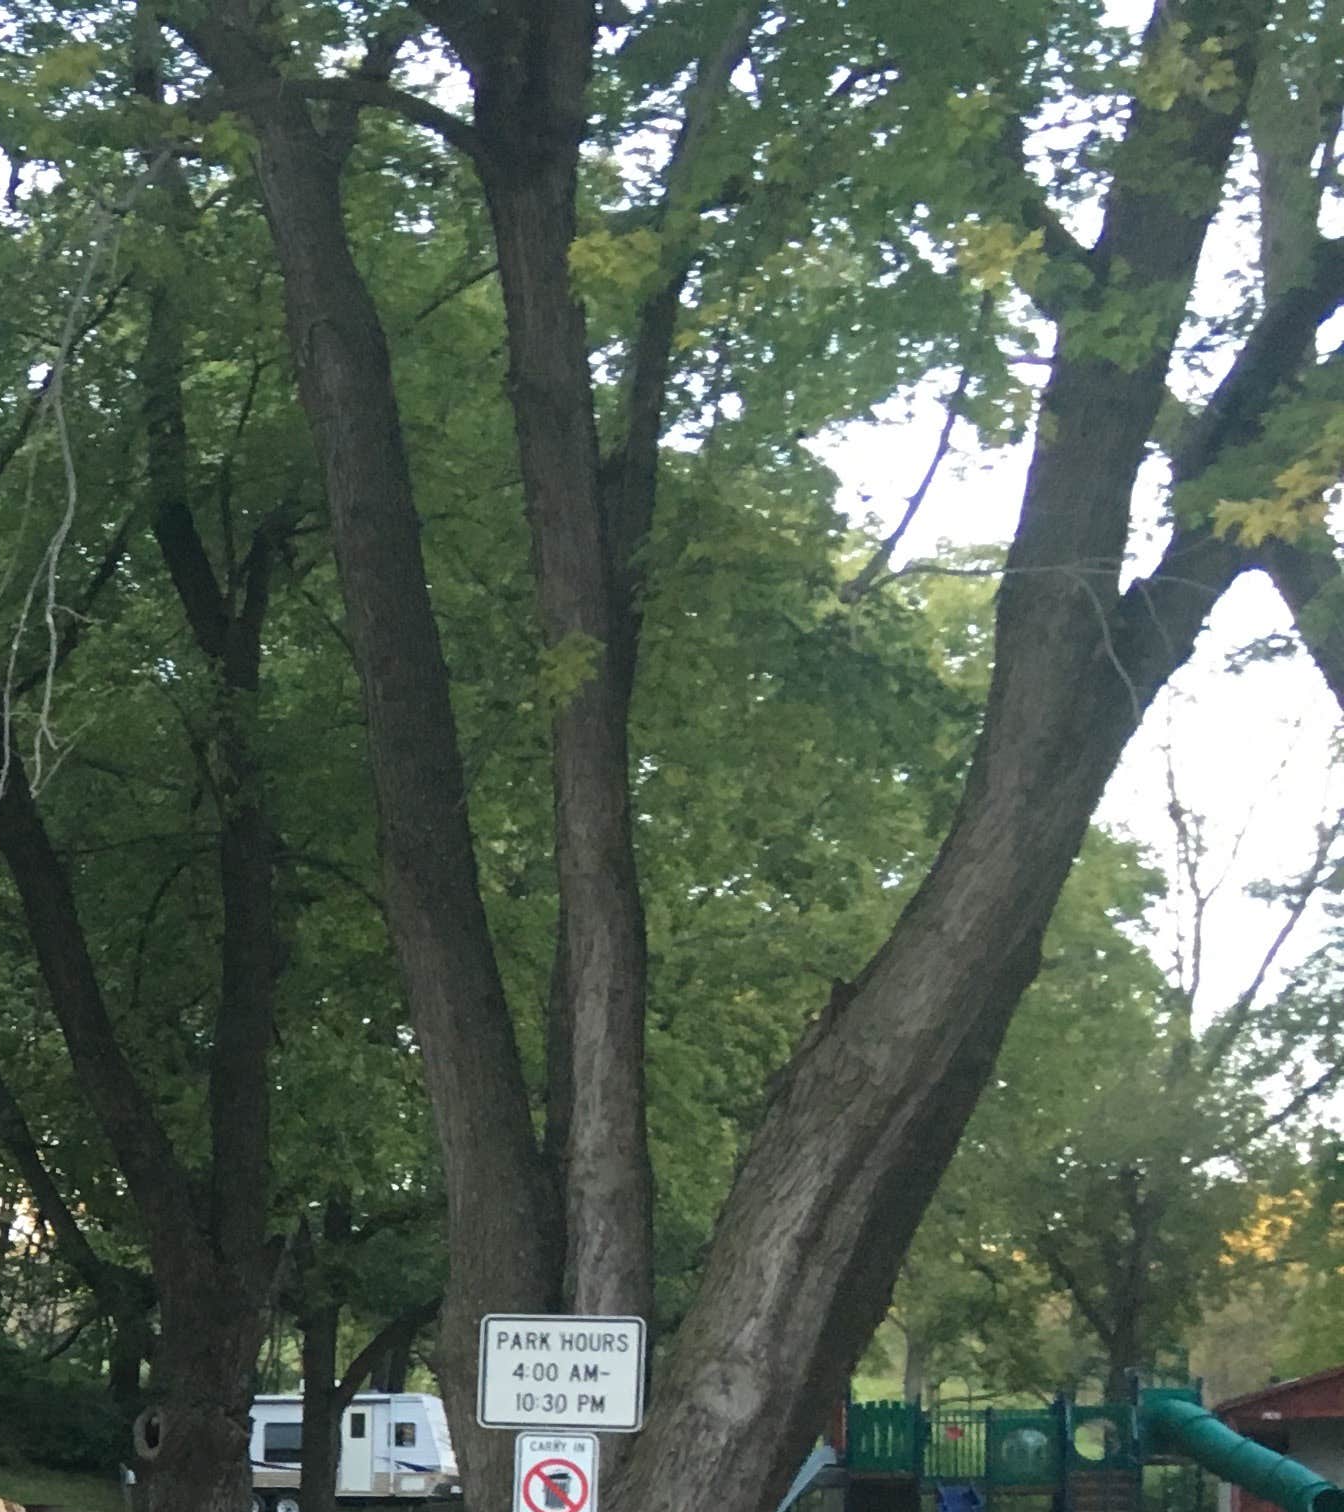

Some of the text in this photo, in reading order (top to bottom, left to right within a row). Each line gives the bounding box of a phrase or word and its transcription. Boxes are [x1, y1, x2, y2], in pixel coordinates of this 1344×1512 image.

[496, 1331, 629, 1353] PARK HOURS
[512, 1363, 559, 1382] 4:00
[516, 1393, 606, 1414] 10:30 PM
[529, 1441, 586, 1453] CARRY IN
